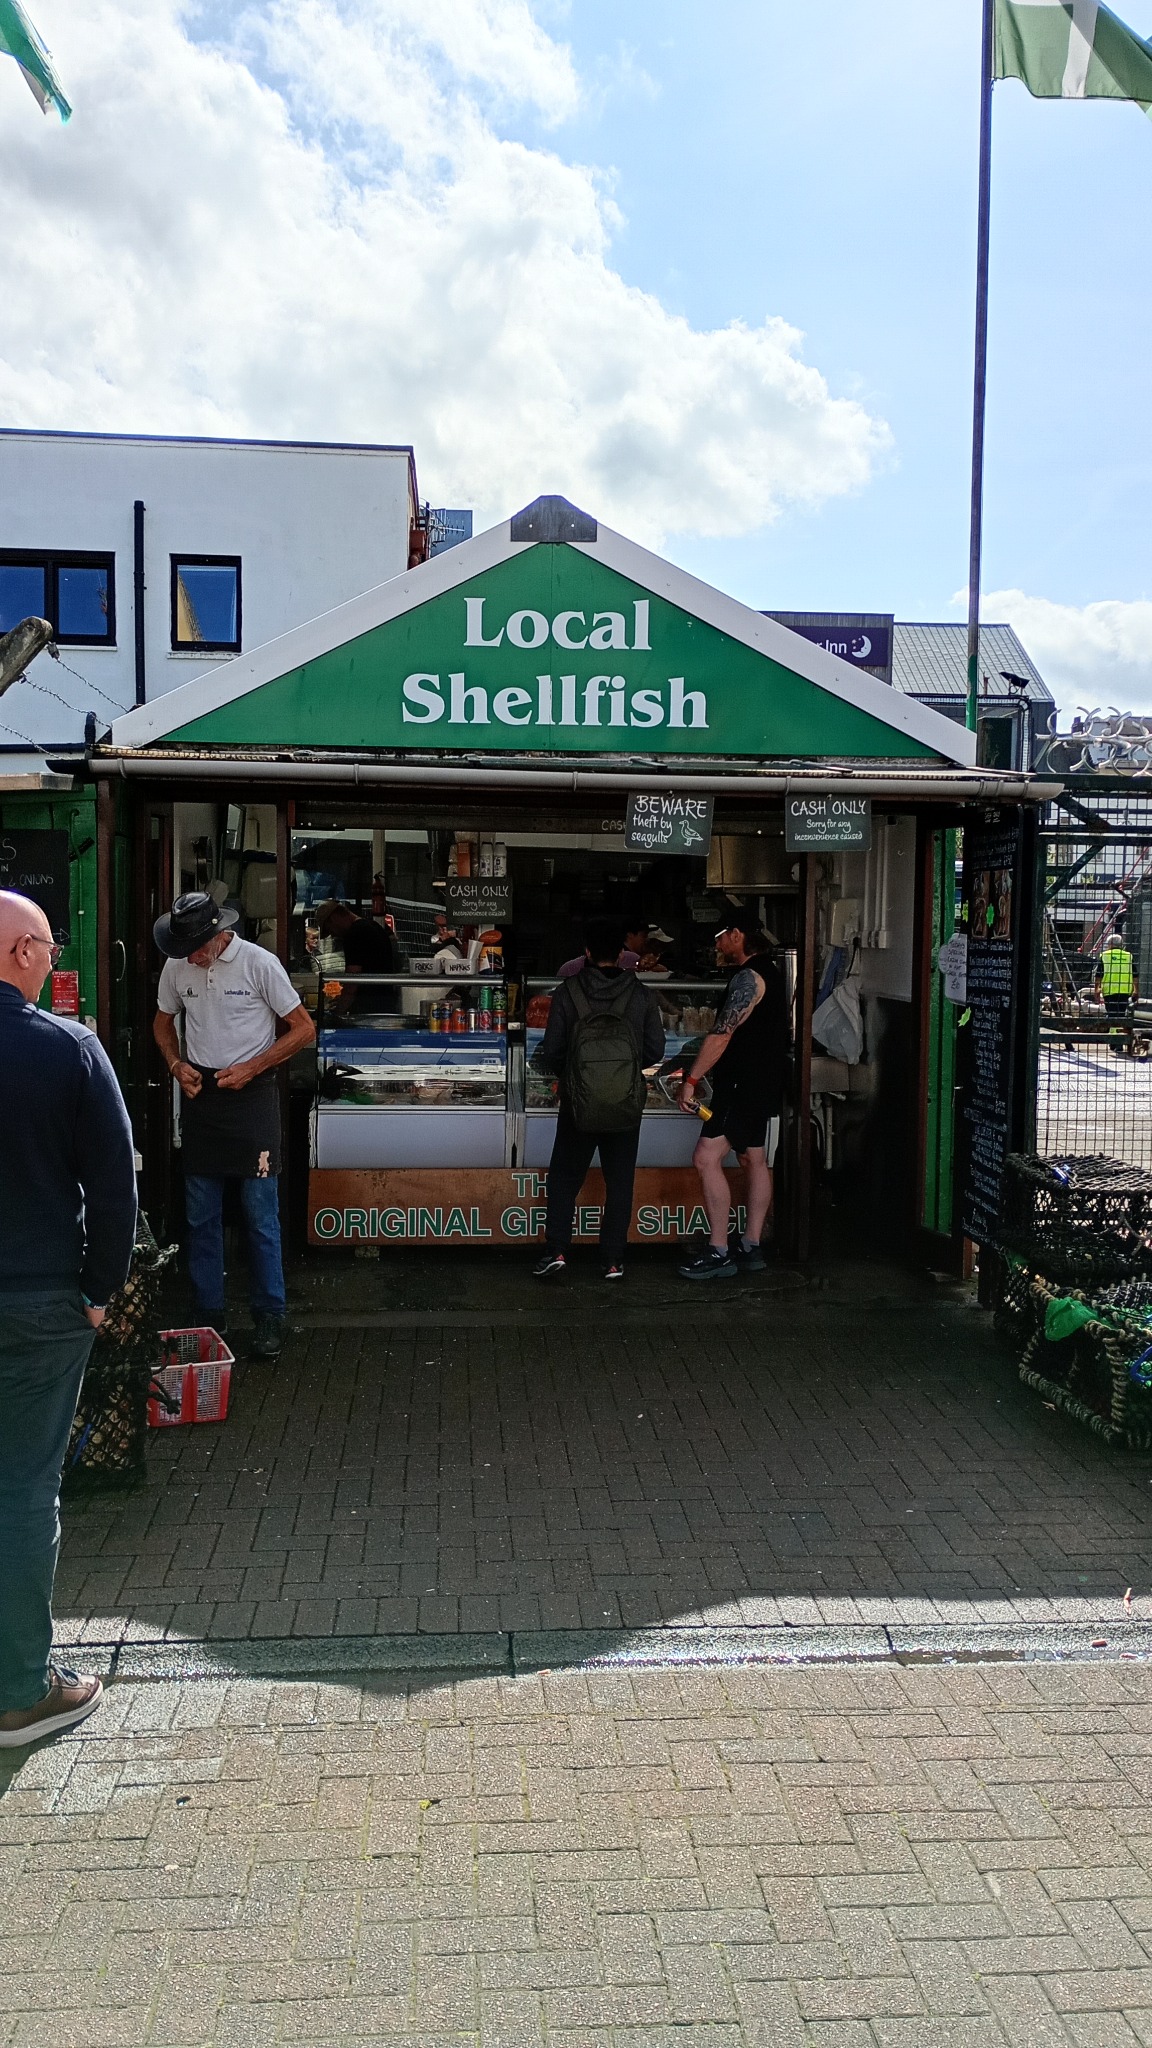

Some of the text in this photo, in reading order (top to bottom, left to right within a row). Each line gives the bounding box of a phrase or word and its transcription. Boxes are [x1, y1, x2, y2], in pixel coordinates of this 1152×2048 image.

[463, 597, 652, 650] Local
[825, 639, 847, 654] Inn
[402, 672, 709, 729] Shellfish
[634, 795, 708, 819] BEWARE
[791, 800, 866, 816] CASH ONLY
[633, 814, 673, 838] theft by
[806, 818, 852, 834] Sorry for any
[631, 831, 670, 849] seagulls
[794, 830, 863, 841] inconvenience caused
[450, 885, 509, 898] CASH ONLY
[462, 899, 478, 911] Sorry
[415, 963, 434, 971] FORKS
[512, 1173, 549, 1197] TH
[315, 1207, 492, 1239] ORIGINAL
[501, 1206, 605, 1237] GRE
